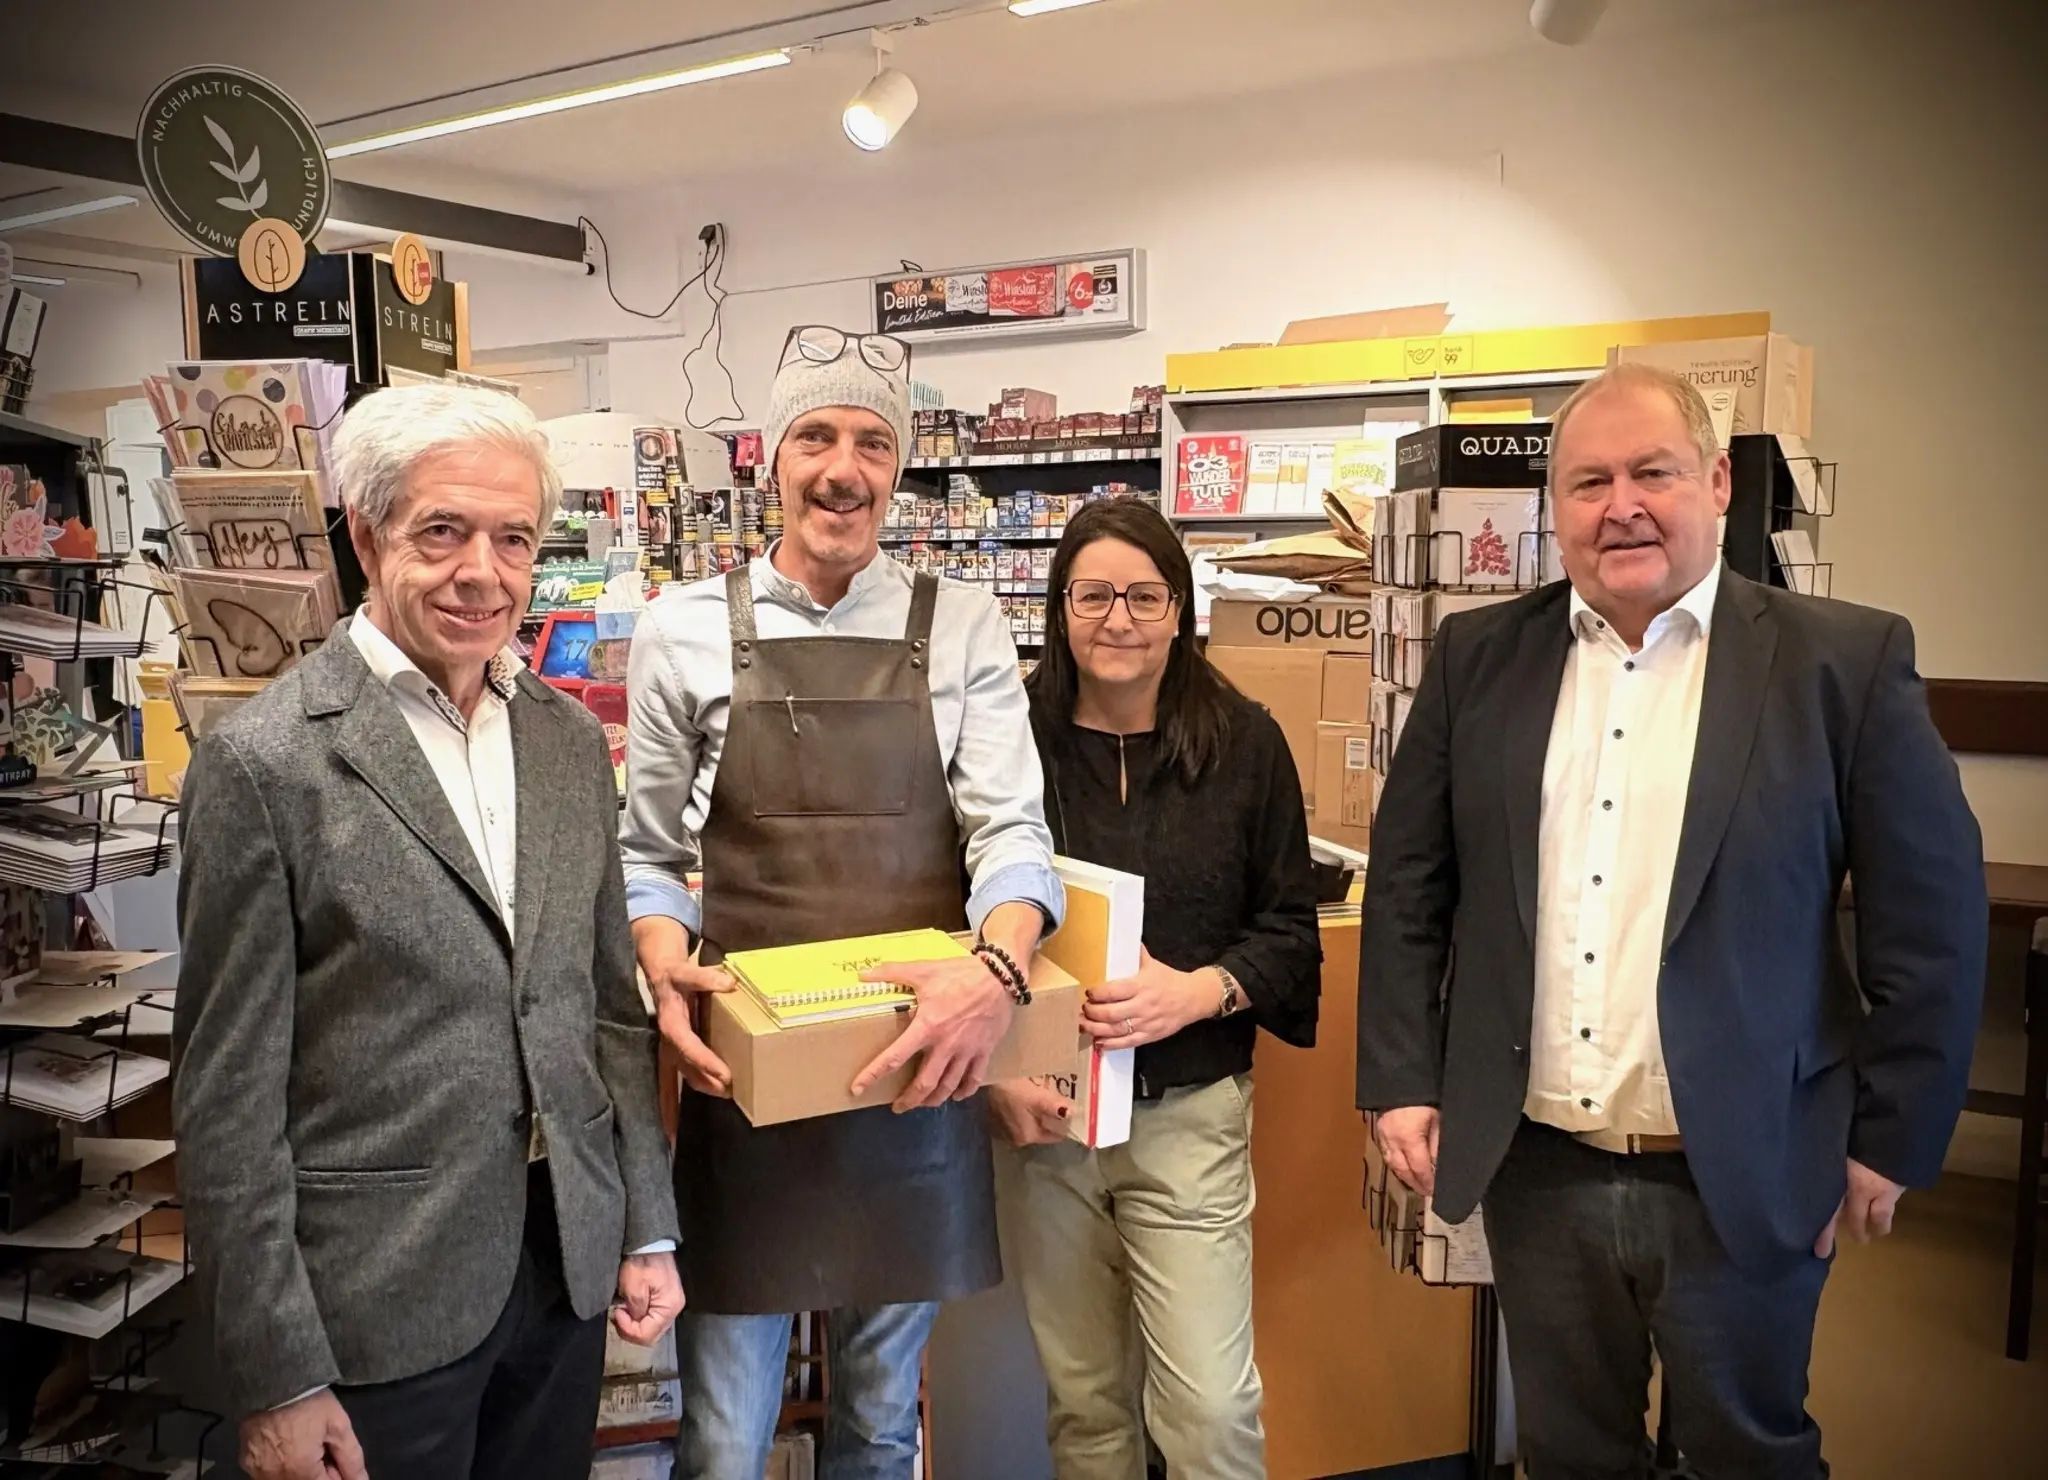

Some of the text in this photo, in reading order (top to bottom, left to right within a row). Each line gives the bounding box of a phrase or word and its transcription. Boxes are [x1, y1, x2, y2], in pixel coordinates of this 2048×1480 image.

[151, 81, 243, 142] NACHHALTIG
[207, 300, 350, 324] ASTREIN
[884, 291, 928, 311] Deine
[384, 306, 453, 341] STREIN
[1444, 353, 1459, 366] 99
[1256, 606, 1371, 643] ando
